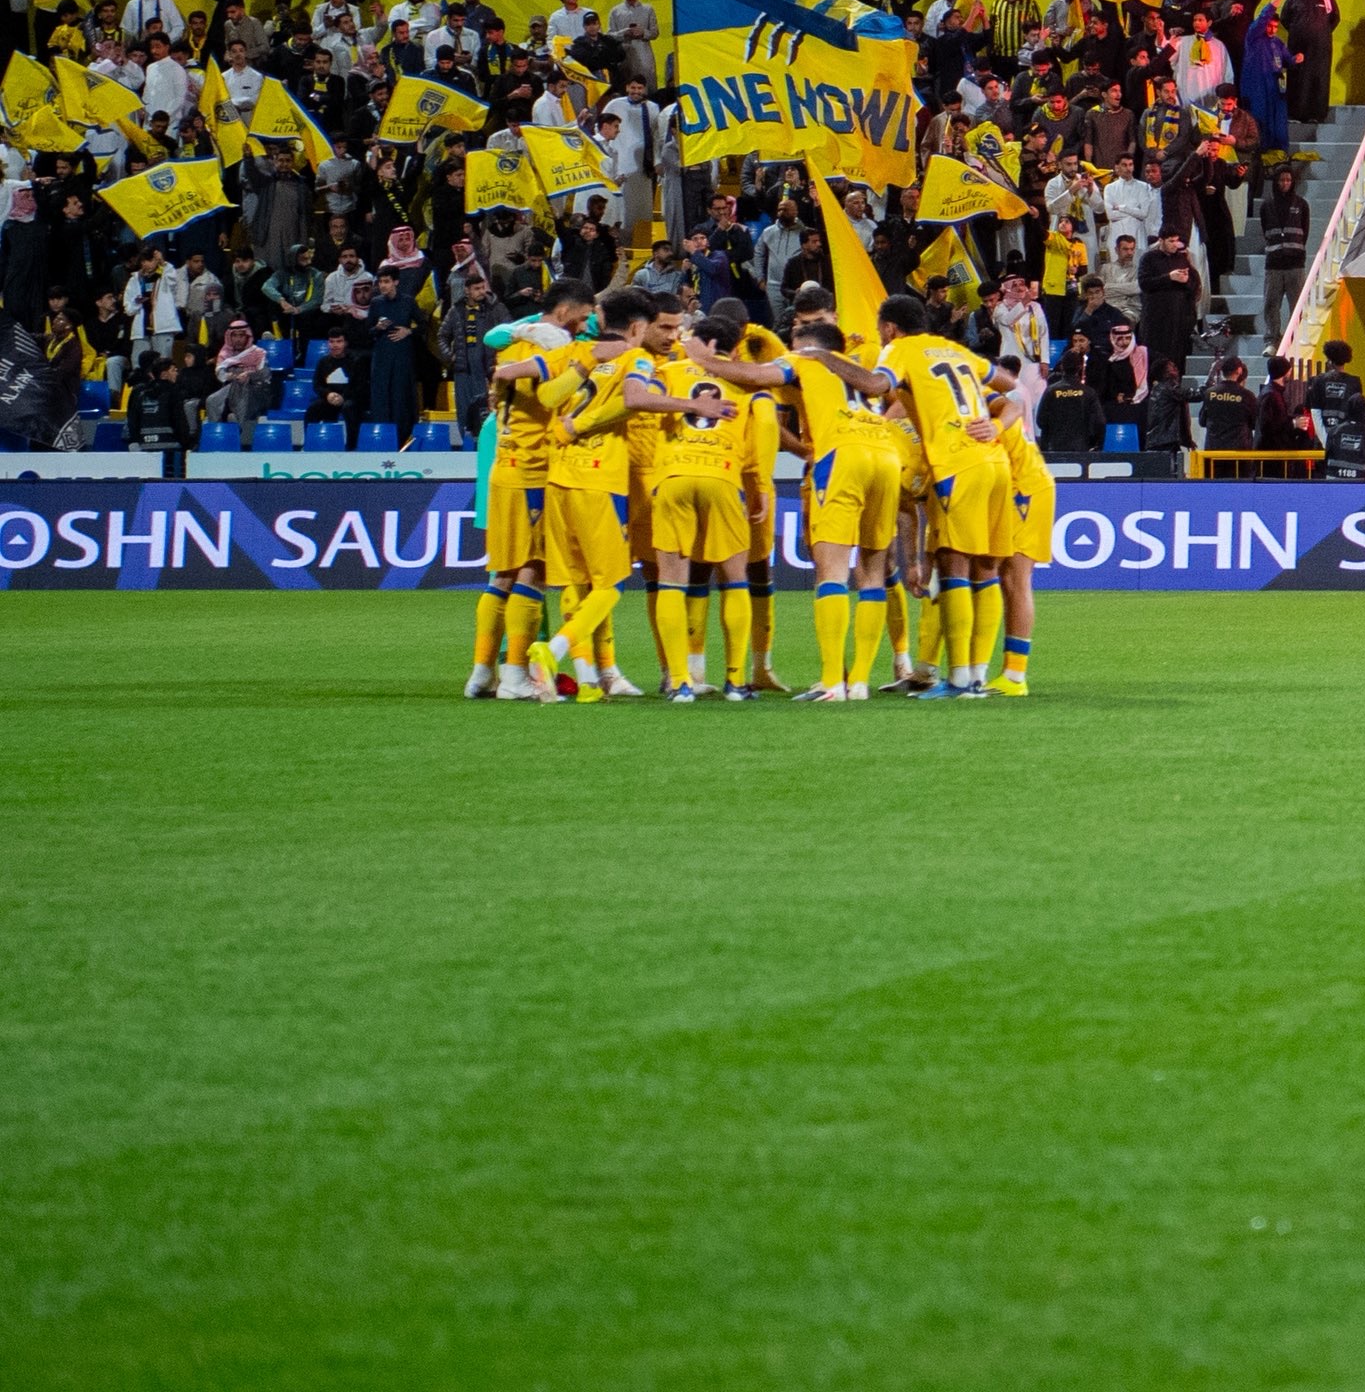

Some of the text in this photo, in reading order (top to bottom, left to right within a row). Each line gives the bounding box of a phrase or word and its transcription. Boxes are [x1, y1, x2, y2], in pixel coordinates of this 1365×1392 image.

[676, 71, 783, 136] ONE
[1055, 389, 1084, 400] Police
[1209, 391, 1243, 404] Police
[1046, 510, 1299, 571] OSHN
